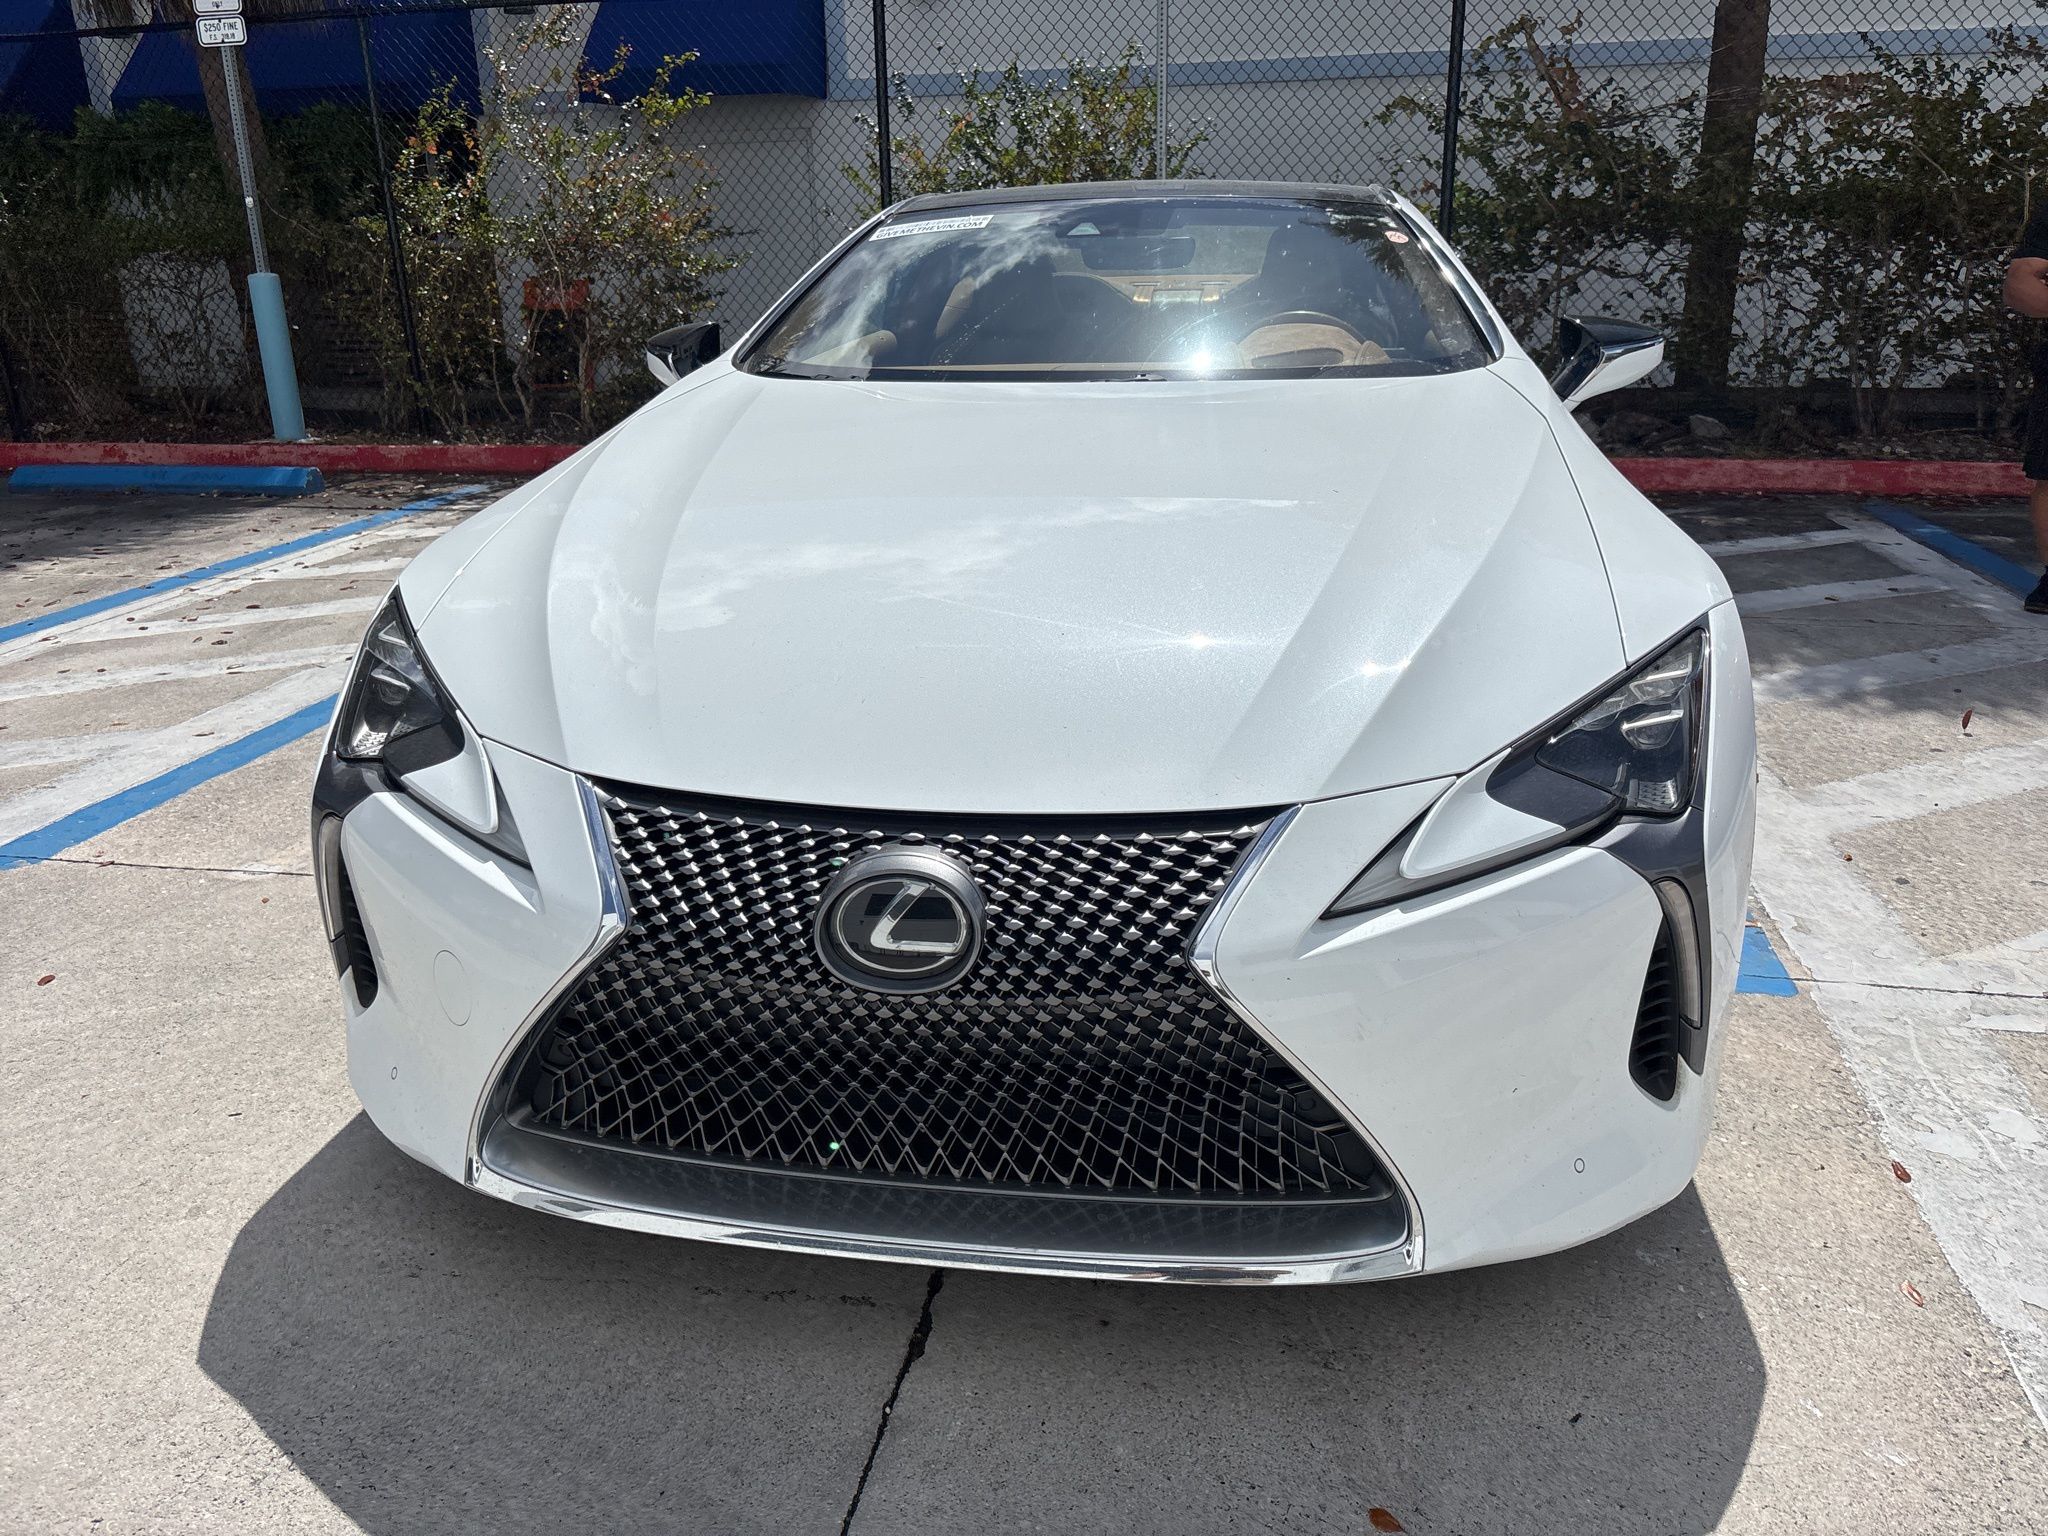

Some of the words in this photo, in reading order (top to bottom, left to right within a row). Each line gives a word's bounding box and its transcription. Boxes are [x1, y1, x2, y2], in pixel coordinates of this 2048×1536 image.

[203, 23, 221, 32] $250
[223, 22, 238, 30] FINE
[876, 221, 983, 239] GIVEMETHEVIN.COM
